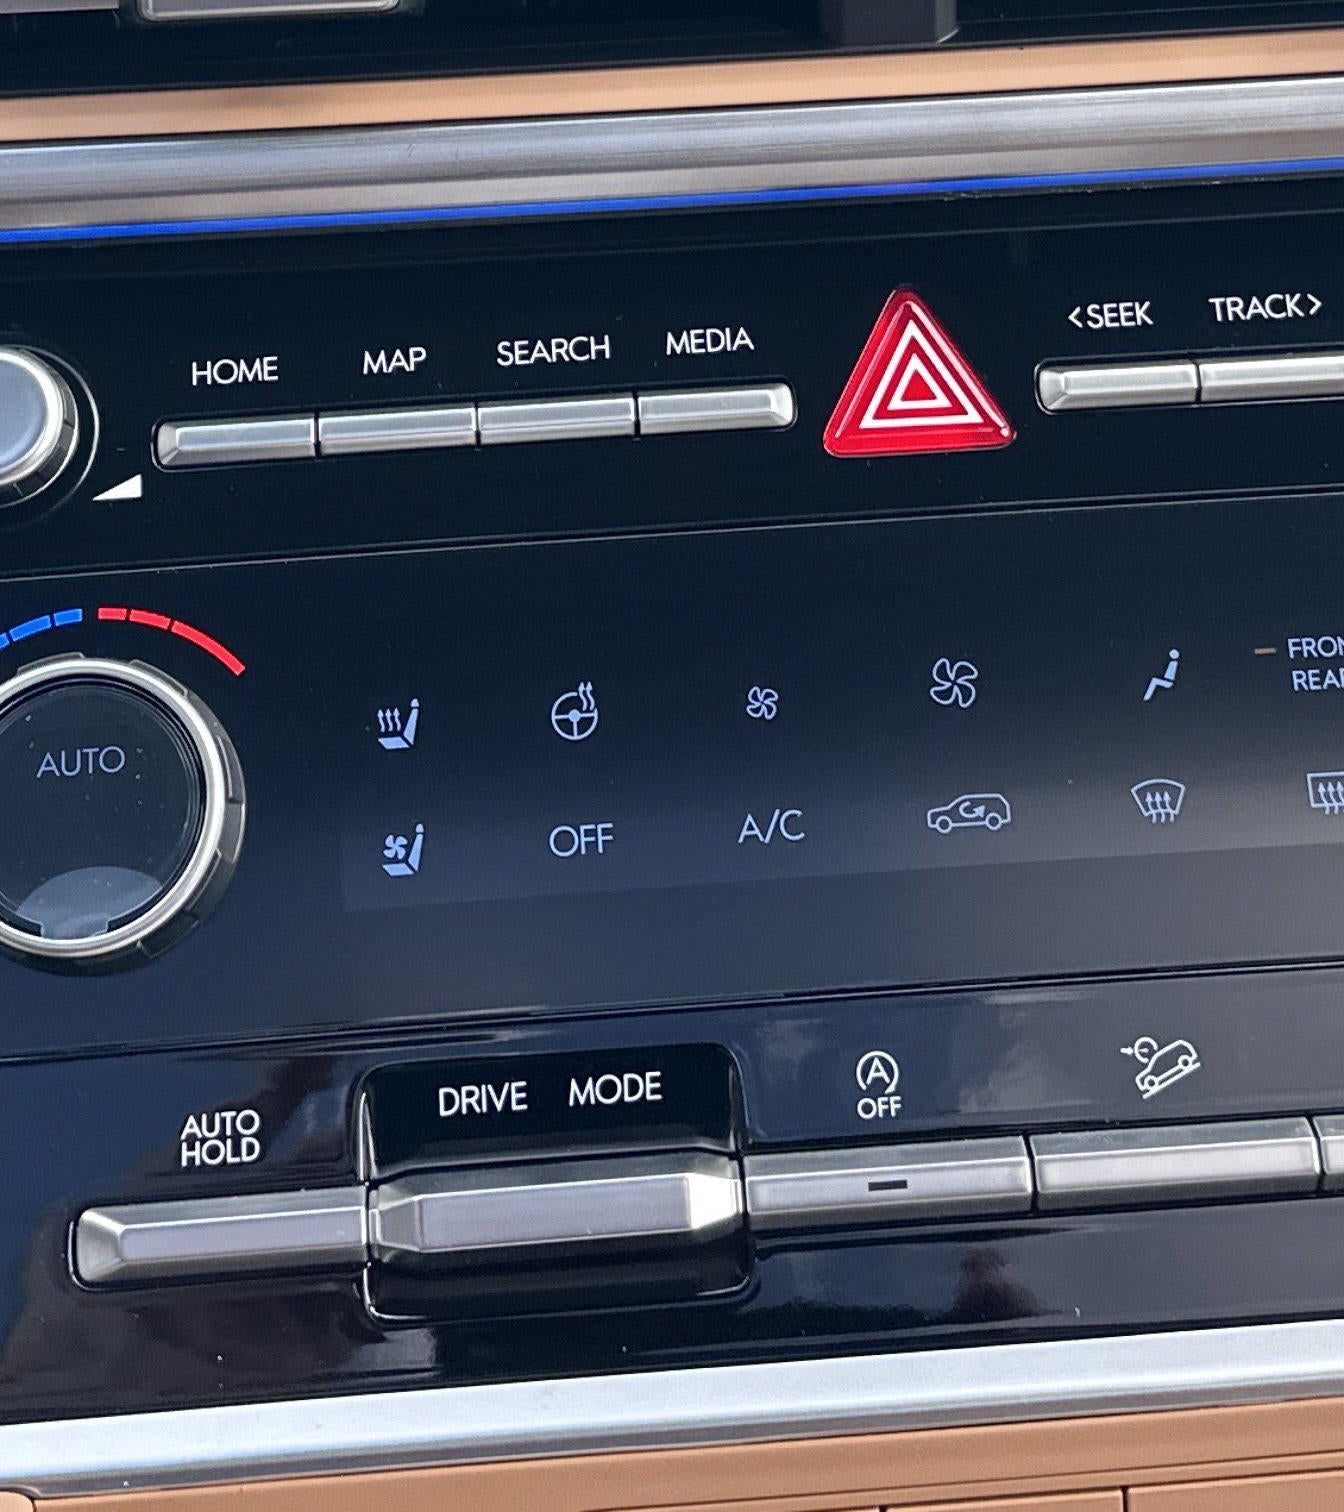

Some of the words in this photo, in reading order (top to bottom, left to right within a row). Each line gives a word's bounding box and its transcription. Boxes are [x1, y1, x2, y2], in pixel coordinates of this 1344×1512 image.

[496, 334, 610, 367] SEARCH
[666, 326, 755, 356] MEDIA
[191, 355, 279, 386] HOME
[362, 346, 427, 375] MAP
[36, 745, 126, 778] AUTO
[549, 822, 614, 857] OFF
[737, 808, 805, 844] A/C
[438, 1080, 528, 1117] DRIVE
[568, 1070, 663, 1107] MODE
[856, 1094, 903, 1120] OFF
[179, 1109, 261, 1140] AUTO
[180, 1136, 261, 1168] HOLD
